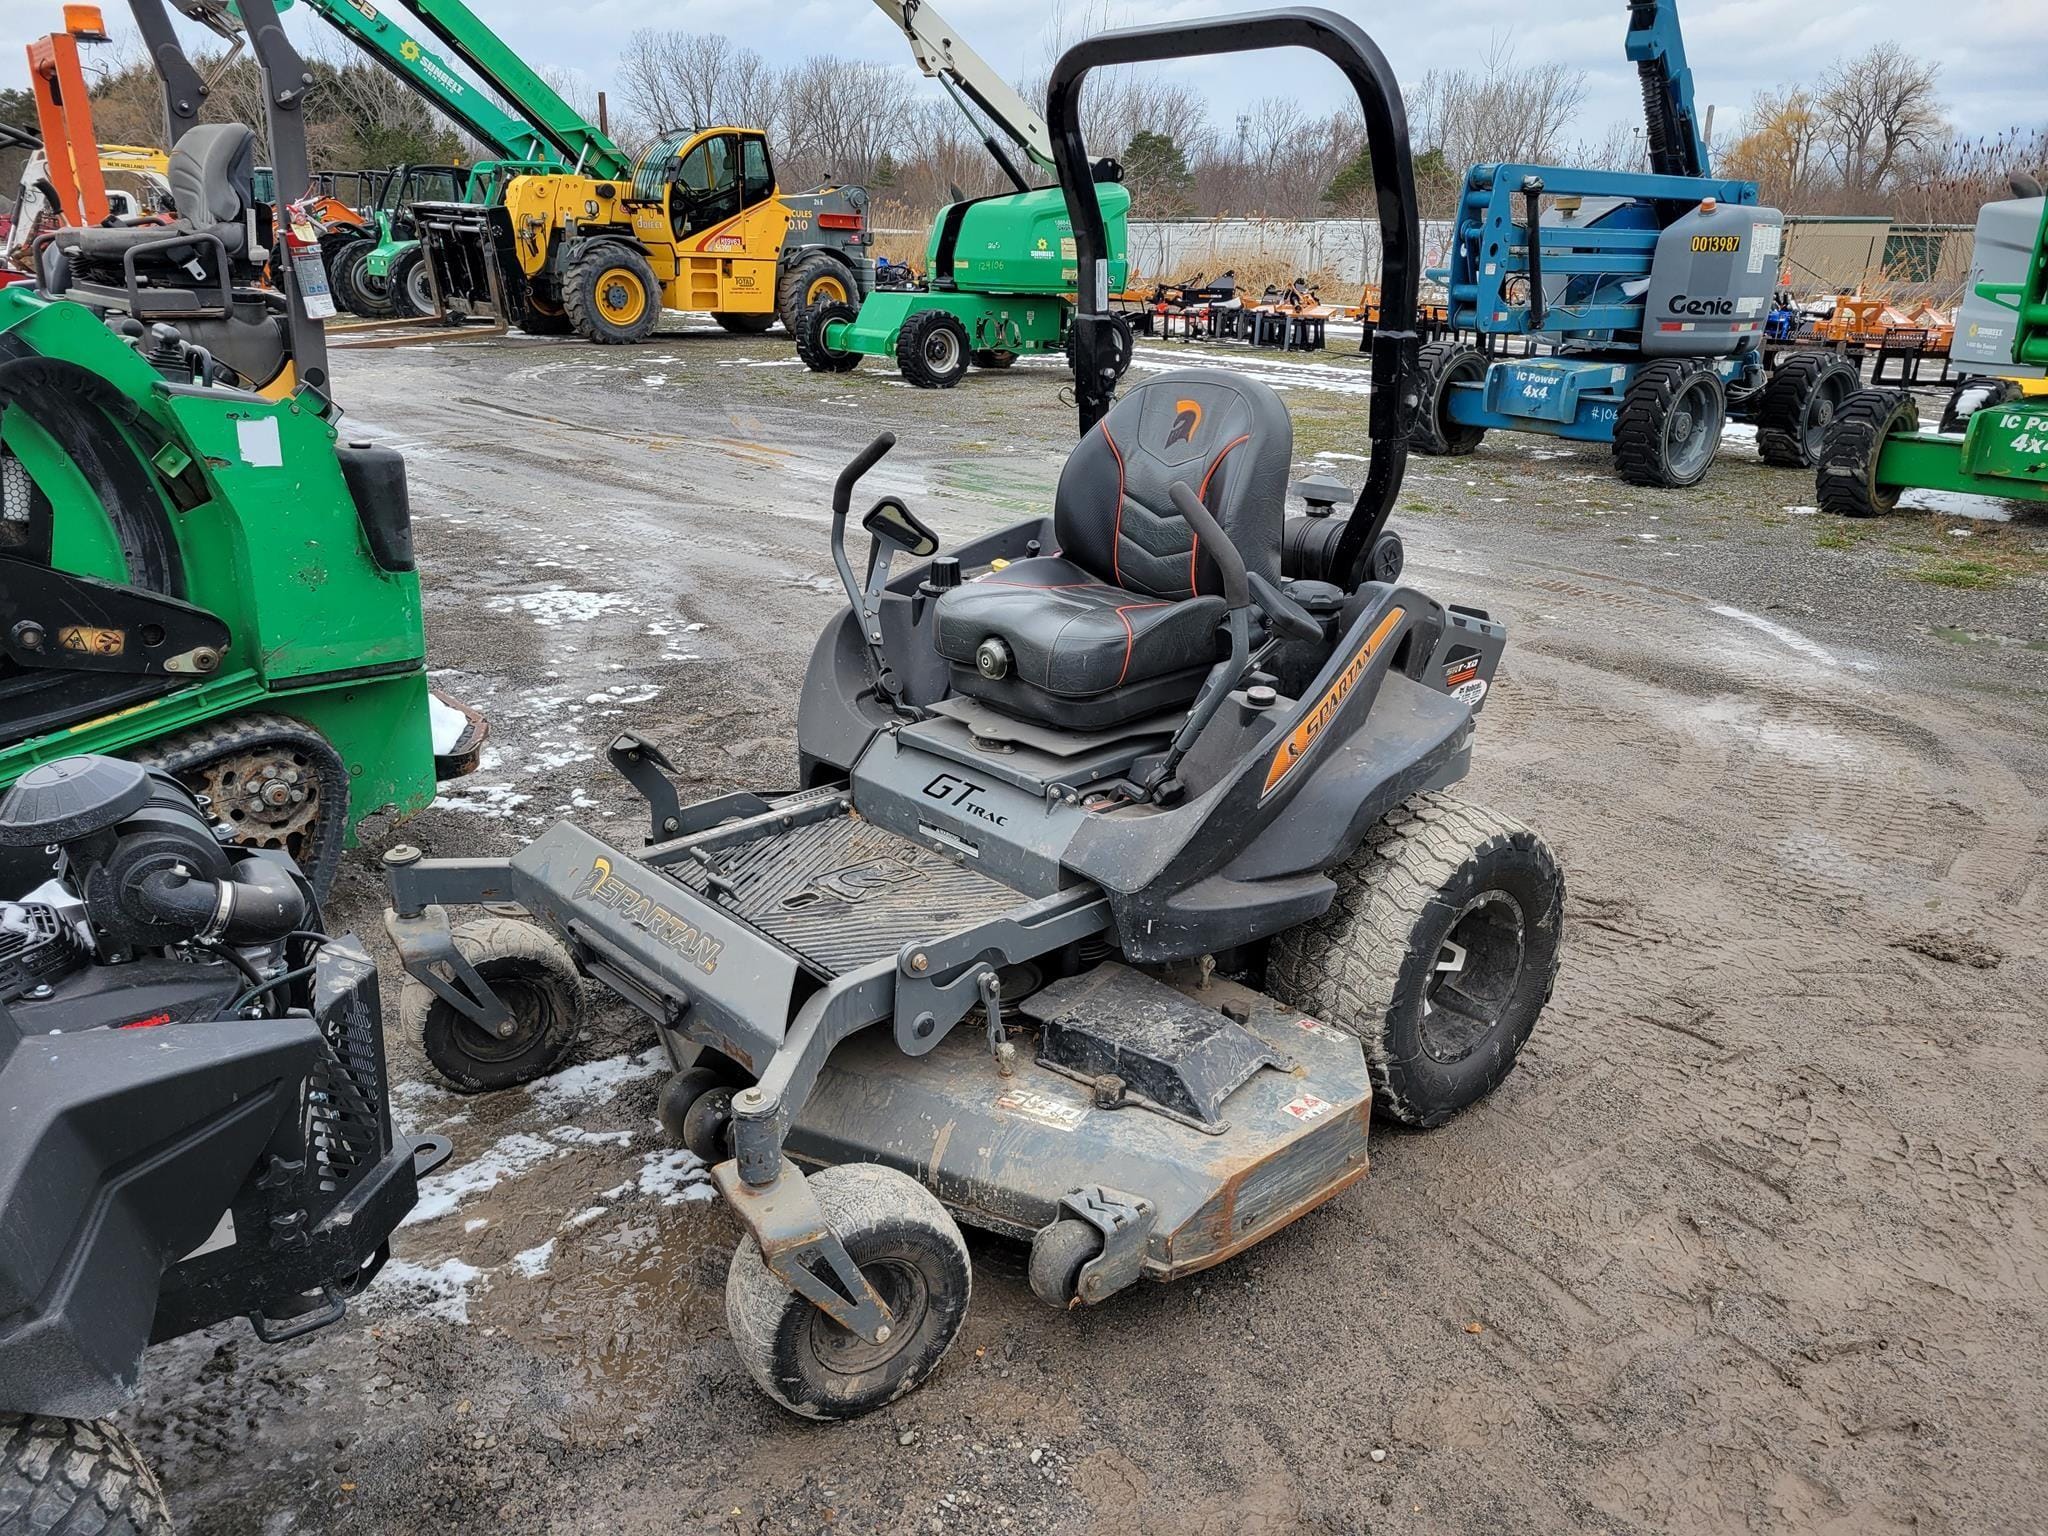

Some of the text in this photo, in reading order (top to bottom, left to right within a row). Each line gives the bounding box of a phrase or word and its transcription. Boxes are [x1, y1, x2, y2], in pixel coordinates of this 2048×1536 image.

[420, 56, 464, 96] SUNBELT
[1692, 236, 1740, 252] 0013987
[1668, 294, 1733, 316] Genie
[1516, 371, 1560, 385] IC Power
[1522, 384, 1549, 399] 4x4
[2000, 414, 2021, 429] IC
[1306, 644, 1371, 736] SPARTAN
[922, 773, 986, 806] GT
[966, 802, 1008, 827] TRAC
[595, 875, 722, 967] SPARTAN
